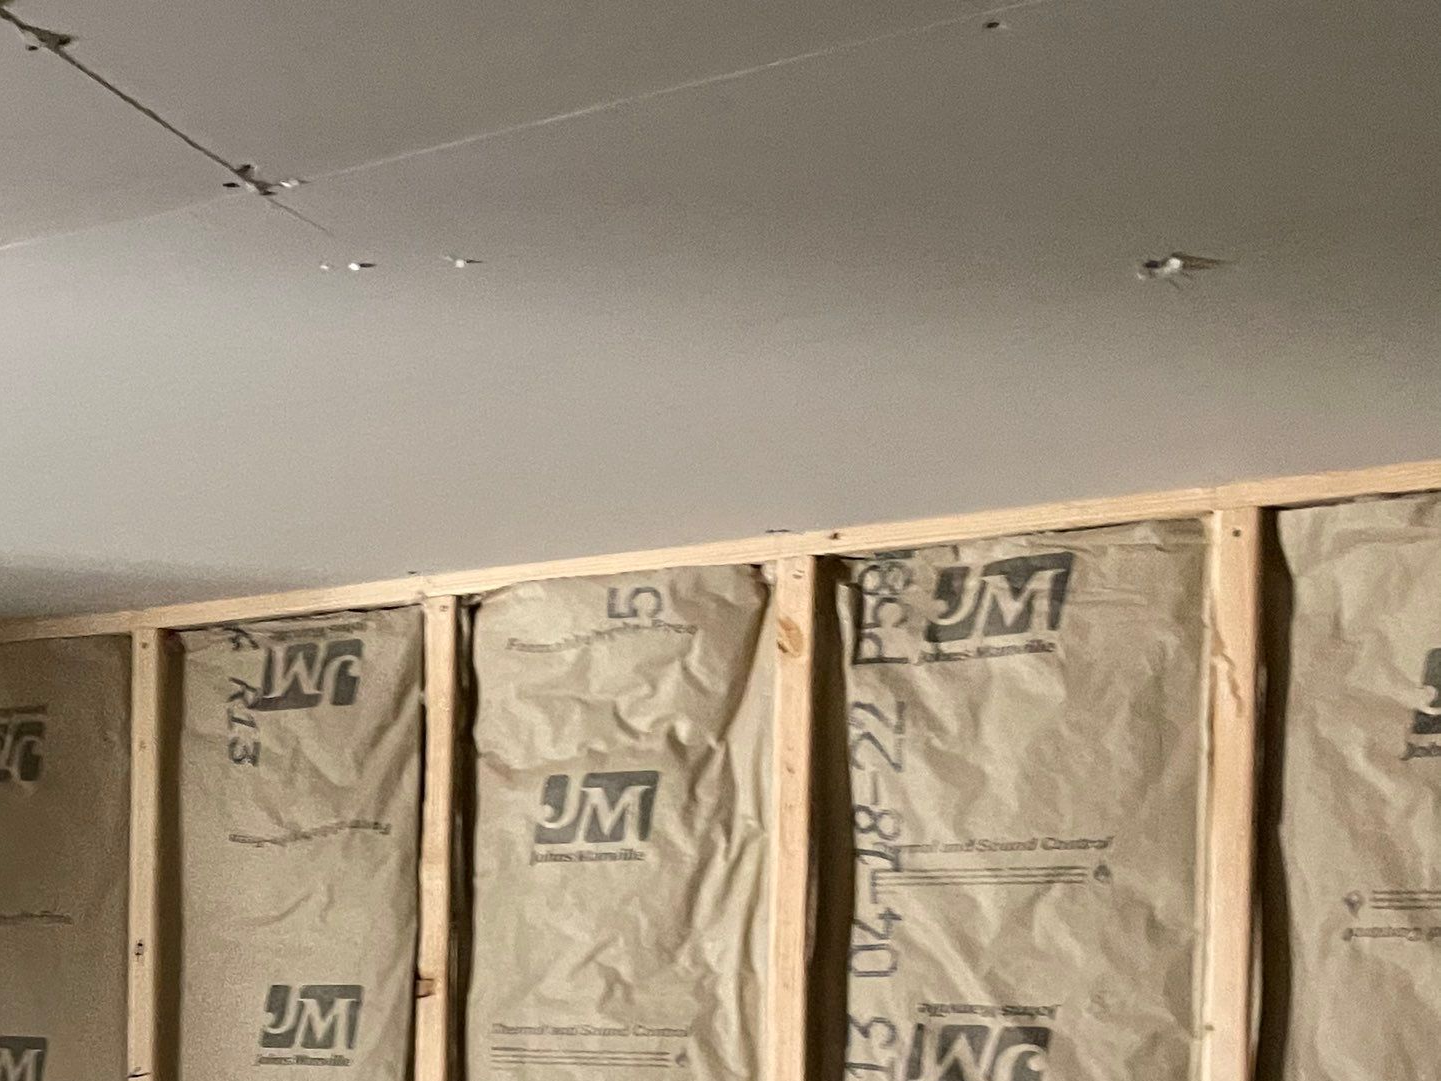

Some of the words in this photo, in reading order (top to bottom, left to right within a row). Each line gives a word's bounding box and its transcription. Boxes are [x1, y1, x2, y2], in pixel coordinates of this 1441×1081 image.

[926, 552, 1074, 643] JM
[263, 639, 364, 712] JM
[535, 770, 659, 845] JM
[850, 700, 907, 979] 04-18-22
[260, 984, 364, 1049] JM
